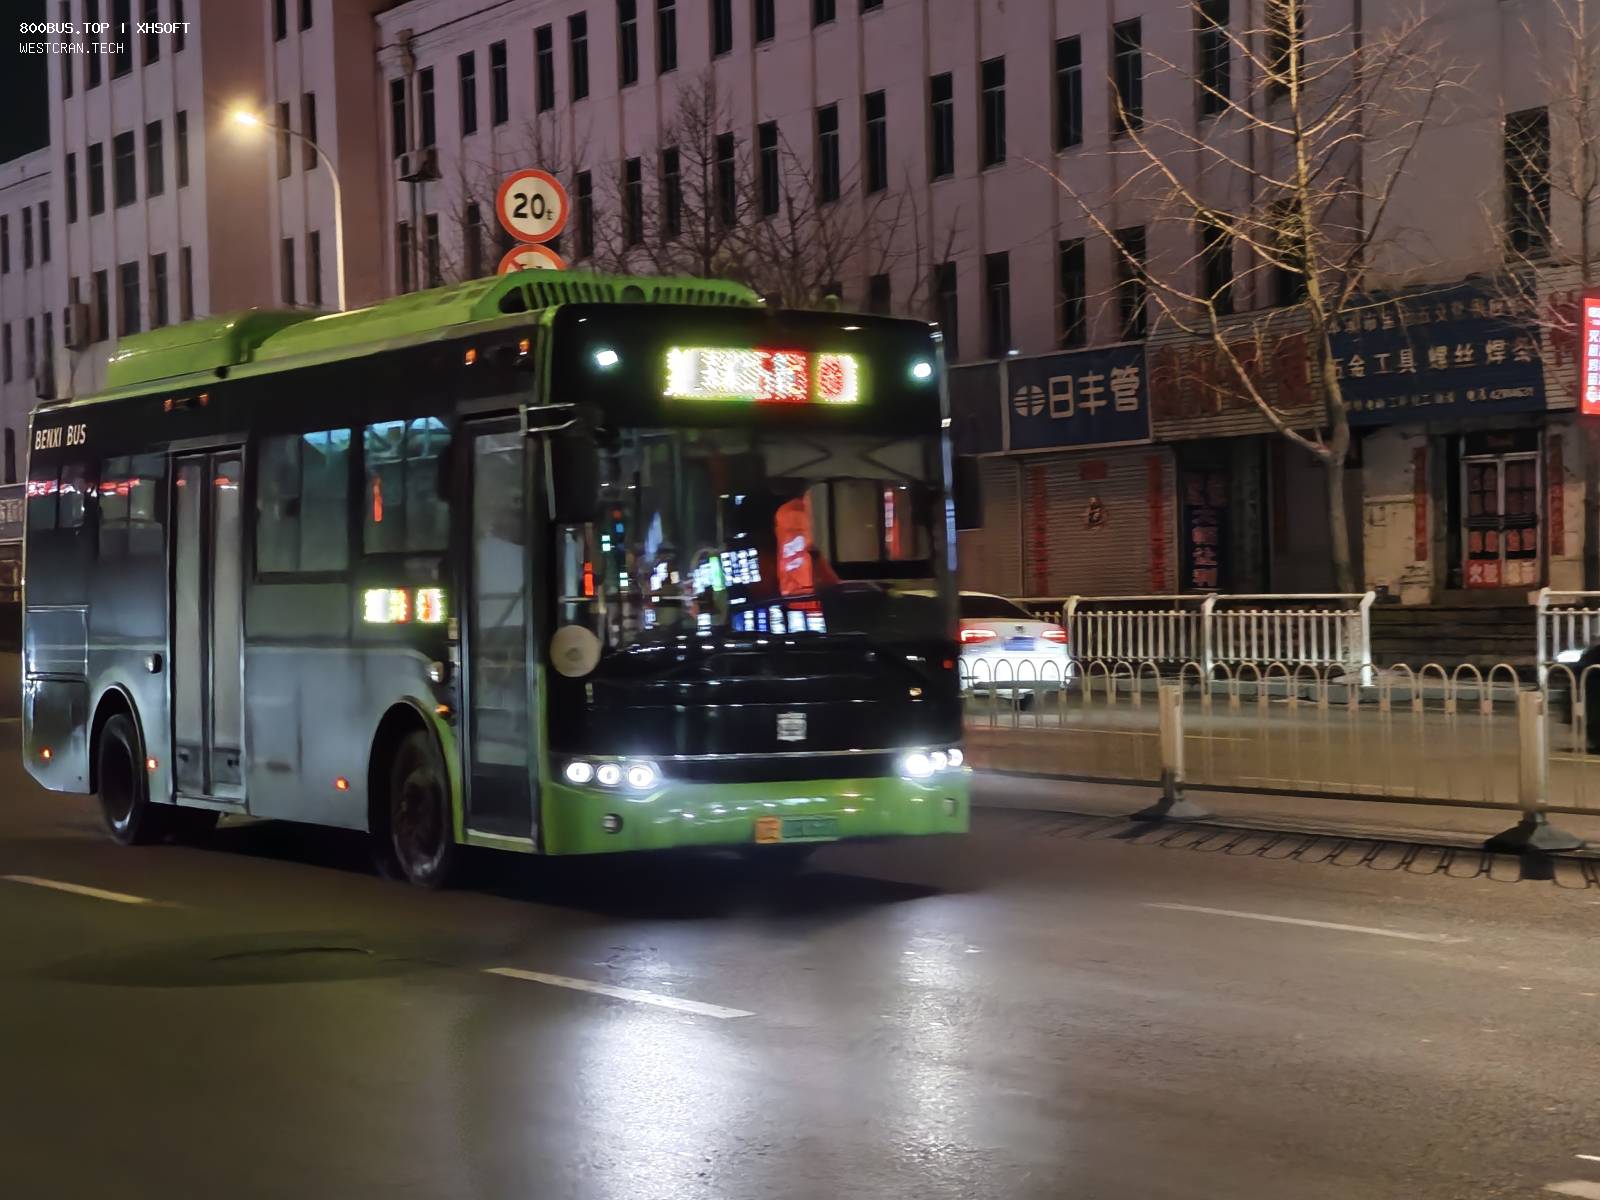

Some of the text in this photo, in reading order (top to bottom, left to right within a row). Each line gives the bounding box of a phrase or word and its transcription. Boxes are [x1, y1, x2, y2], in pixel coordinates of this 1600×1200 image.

[1048, 366, 1140, 419] 日丰管
[35, 423, 87, 450] BENXI BUS
